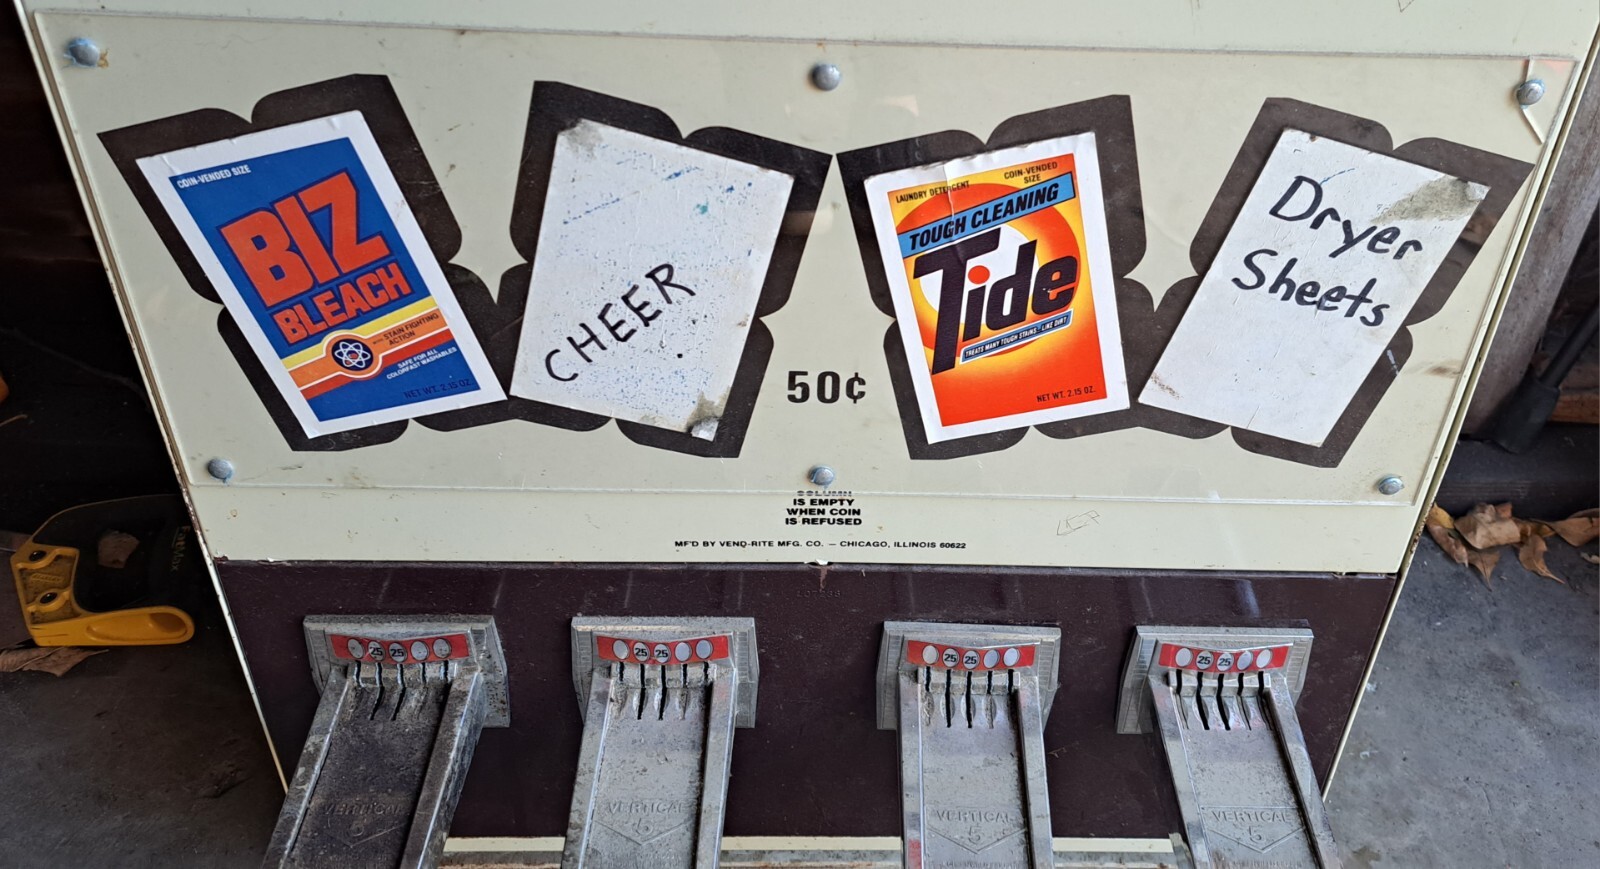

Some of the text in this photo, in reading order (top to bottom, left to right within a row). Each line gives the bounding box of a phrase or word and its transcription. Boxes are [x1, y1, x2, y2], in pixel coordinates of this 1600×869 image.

[177, 164, 252, 188] COIN-VENDED SIZE
[1004, 161, 1058, 180] COIN-VENDED
[1024, 173, 1041, 184] SIZE
[896, 180, 970, 203] LAUNDRY DETERGENT
[909, 183, 1059, 250] TOUGH CLEANING
[1269, 175, 1423, 260] Dryer
[218, 169, 391, 308] BIZ
[1231, 249, 1391, 327] Sheets
[273, 263, 412, 344] BLEACH
[913, 227, 1078, 376] Tide
[383, 313, 439, 340] STAIN FIGHTING
[545, 263, 696, 382] CHEER
[389, 331, 416, 346] ACTION
[965, 345, 984, 358] TREATS
[984, 340, 1000, 350] MANY
[1000, 335, 1018, 345] TOUGH
[1054, 316, 1067, 327] DIRT
[386, 346, 457, 379] COLORFAST WASHABLES
[397, 348, 438, 369] SAFE FOR ALL
[404, 388, 420, 399] NET
[440, 381, 458, 391] 2.15
[787, 370, 867, 404] 50¢
[1036, 393, 1050, 402] NET
[1052, 391, 1065, 399] WT.
[1067, 387, 1082, 397] 2.15
[793, 498, 855, 506] IS EMPTY
[785, 517, 798, 525] IS
[786, 508, 861, 516] WHEN COIN
[839, 540, 891, 549] CHICAGO,
[369, 646, 404, 657] 25 25
[635, 647, 669, 658] 25 25
[944, 653, 977, 665] 25 25
[1197, 655, 1231, 667] 25 25
[936, 809, 1014, 823] VERTICAL
[1211, 810, 1293, 823] VERTICAL
[967, 825, 982, 845] 5
[1247, 825, 1263, 844] 5
